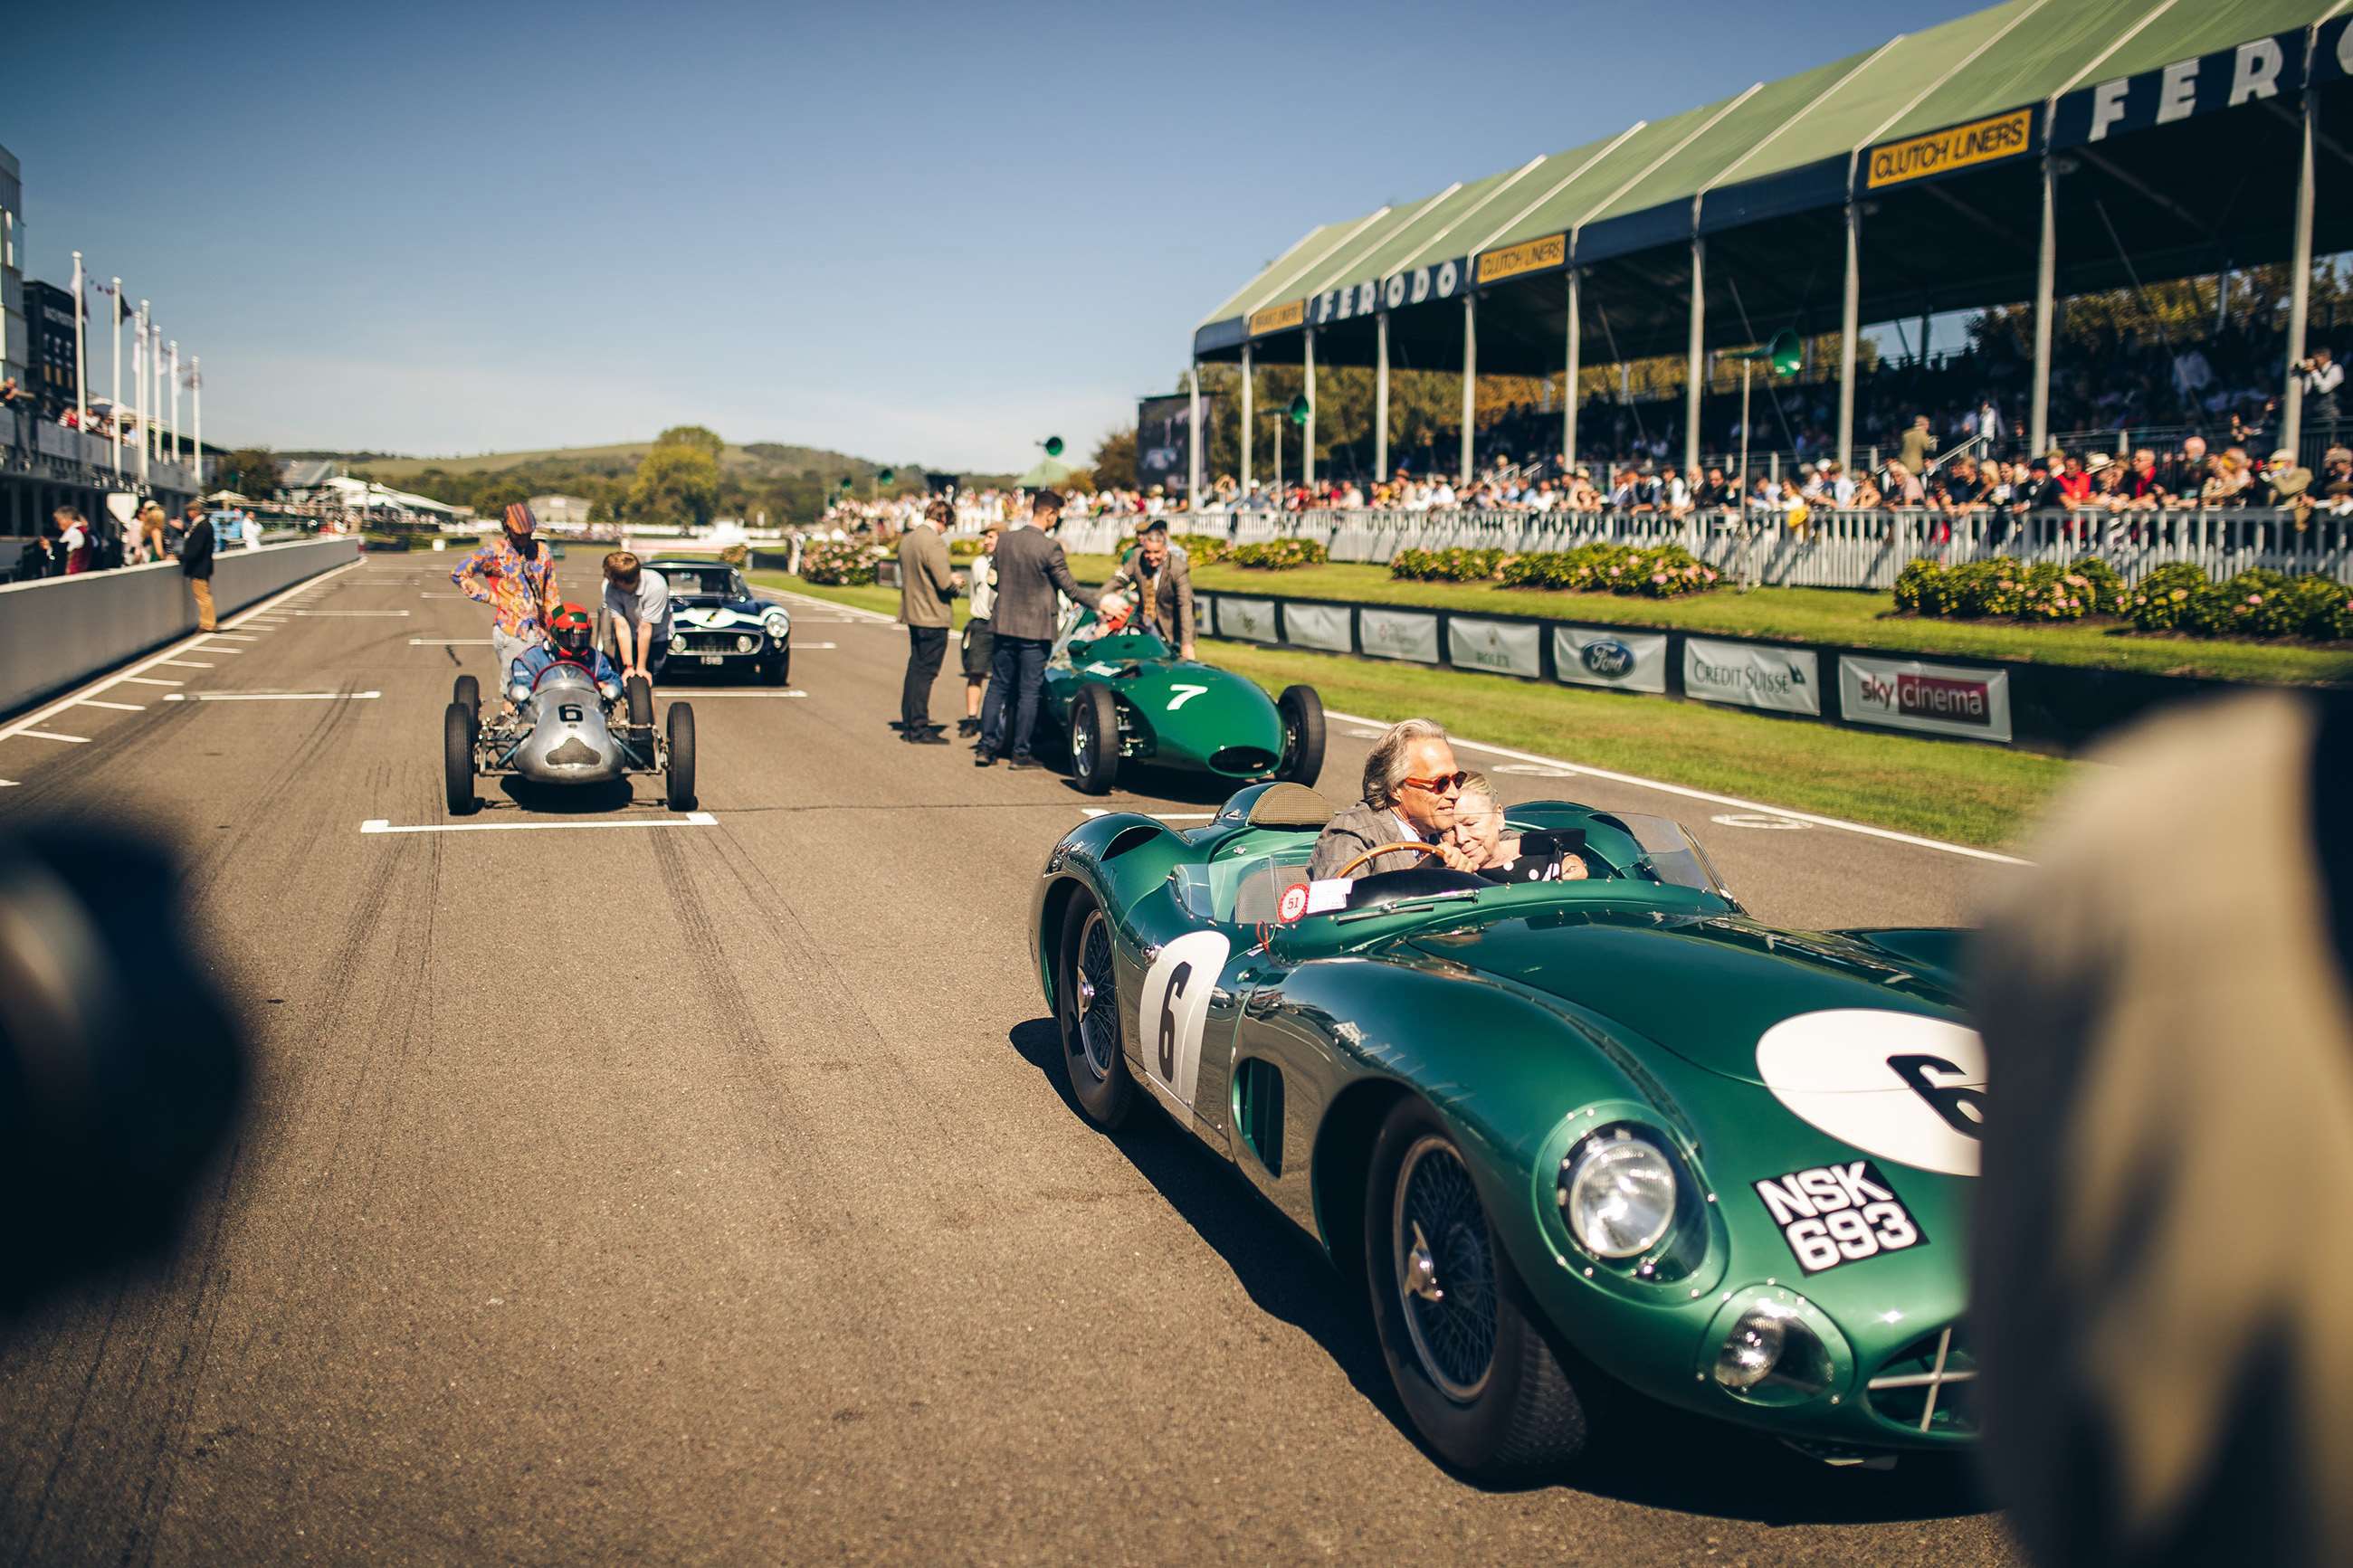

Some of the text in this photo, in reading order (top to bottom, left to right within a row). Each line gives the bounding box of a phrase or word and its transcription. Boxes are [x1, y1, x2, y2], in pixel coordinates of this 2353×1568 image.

[1875, 118, 2024, 180] CLUTCH LINERS
[1318, 261, 1458, 324] FERODO
[1589, 643, 1627, 673] Ford
[1694, 660, 1789, 695] CREDIT SUISSE
[557, 703, 584, 723] 6
[1166, 683, 1209, 711] 7
[1861, 675, 1984, 716] sky cinema
[1157, 961, 1193, 1084] 6
[1886, 1054, 1986, 1142] 6
[1756, 1161, 1894, 1225] NSK
[1786, 1201, 1918, 1271] 693
